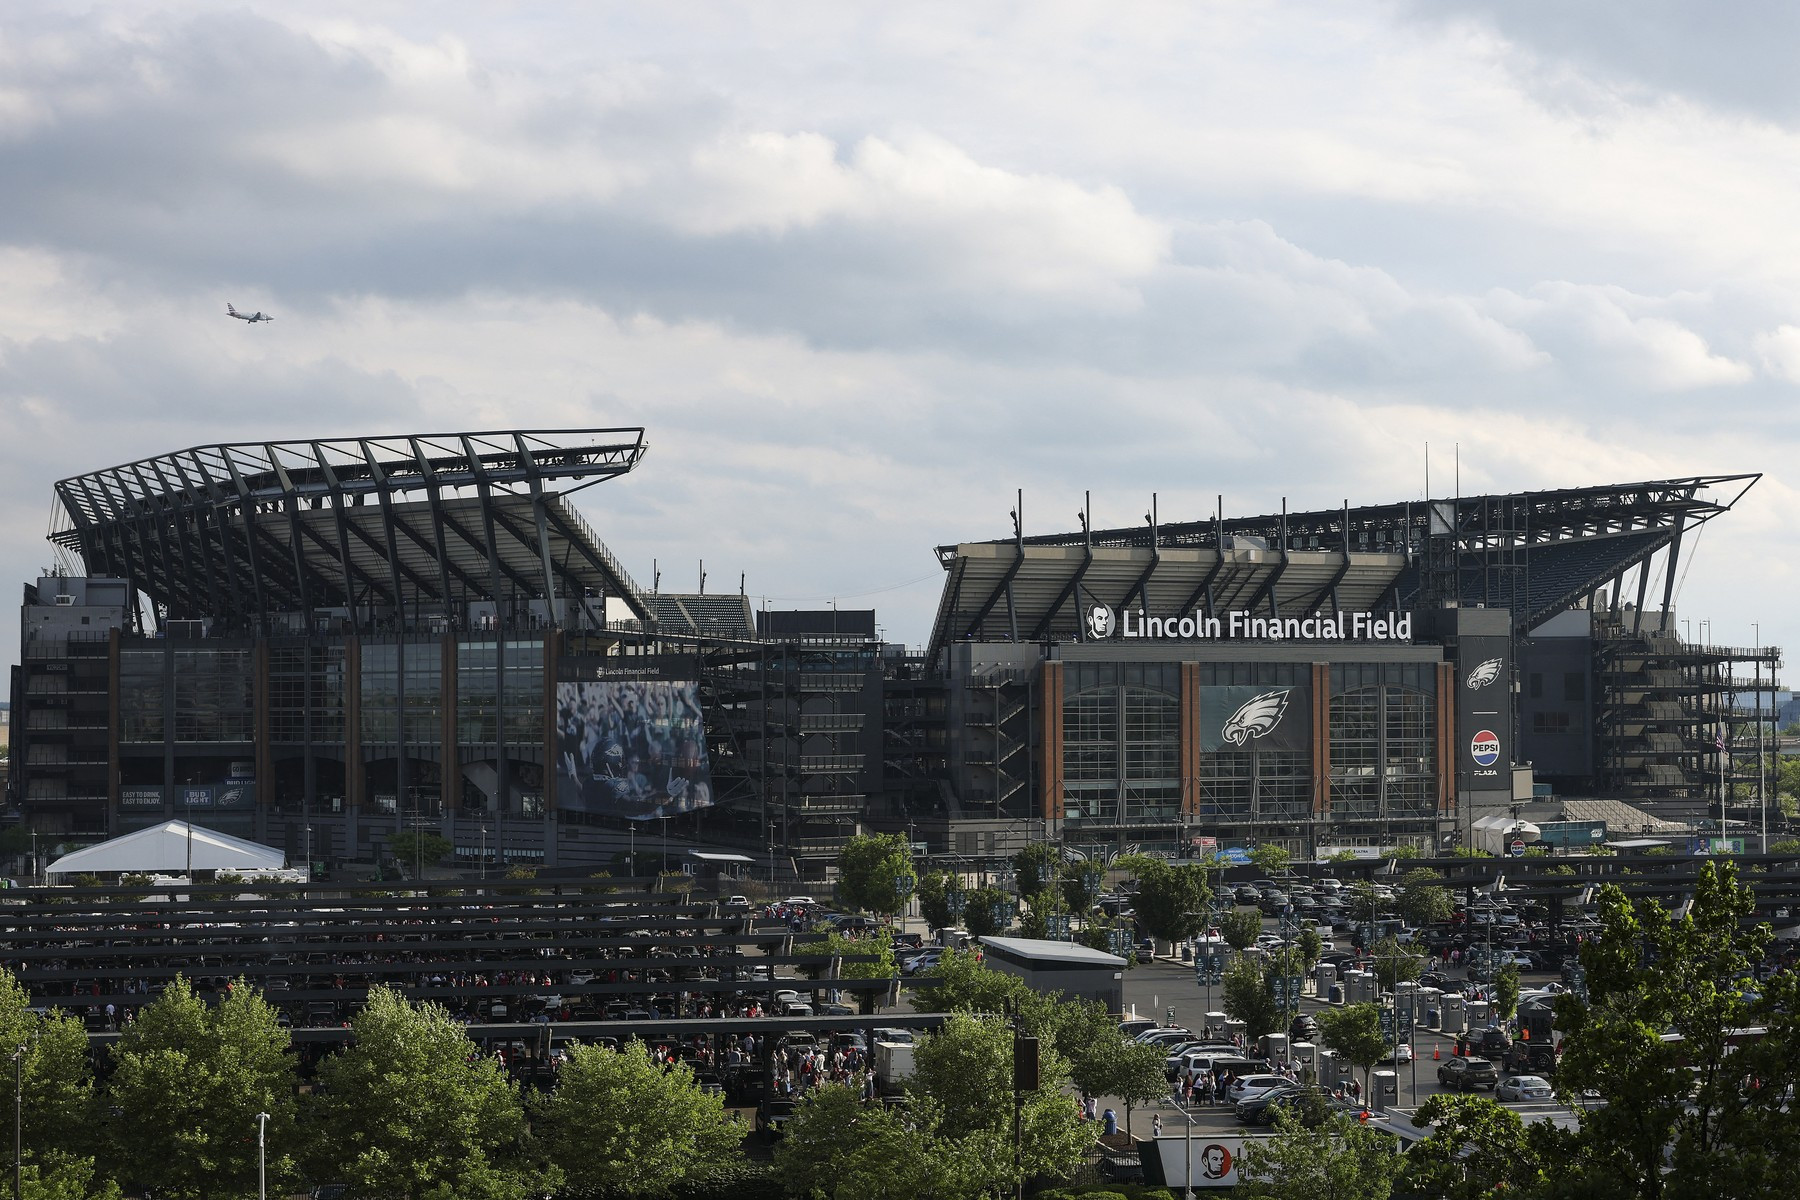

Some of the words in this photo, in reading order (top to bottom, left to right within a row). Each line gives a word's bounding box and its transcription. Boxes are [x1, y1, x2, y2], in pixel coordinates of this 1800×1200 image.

[1123, 609, 1221, 638] Lincoln
[1229, 610, 1346, 639] Financial
[1353, 611, 1412, 639] Field
[605, 667, 624, 675] Lincoln
[624, 667, 646, 675] Financial
[647, 667, 660, 675] Field
[1473, 744, 1498, 752] PEPSI
